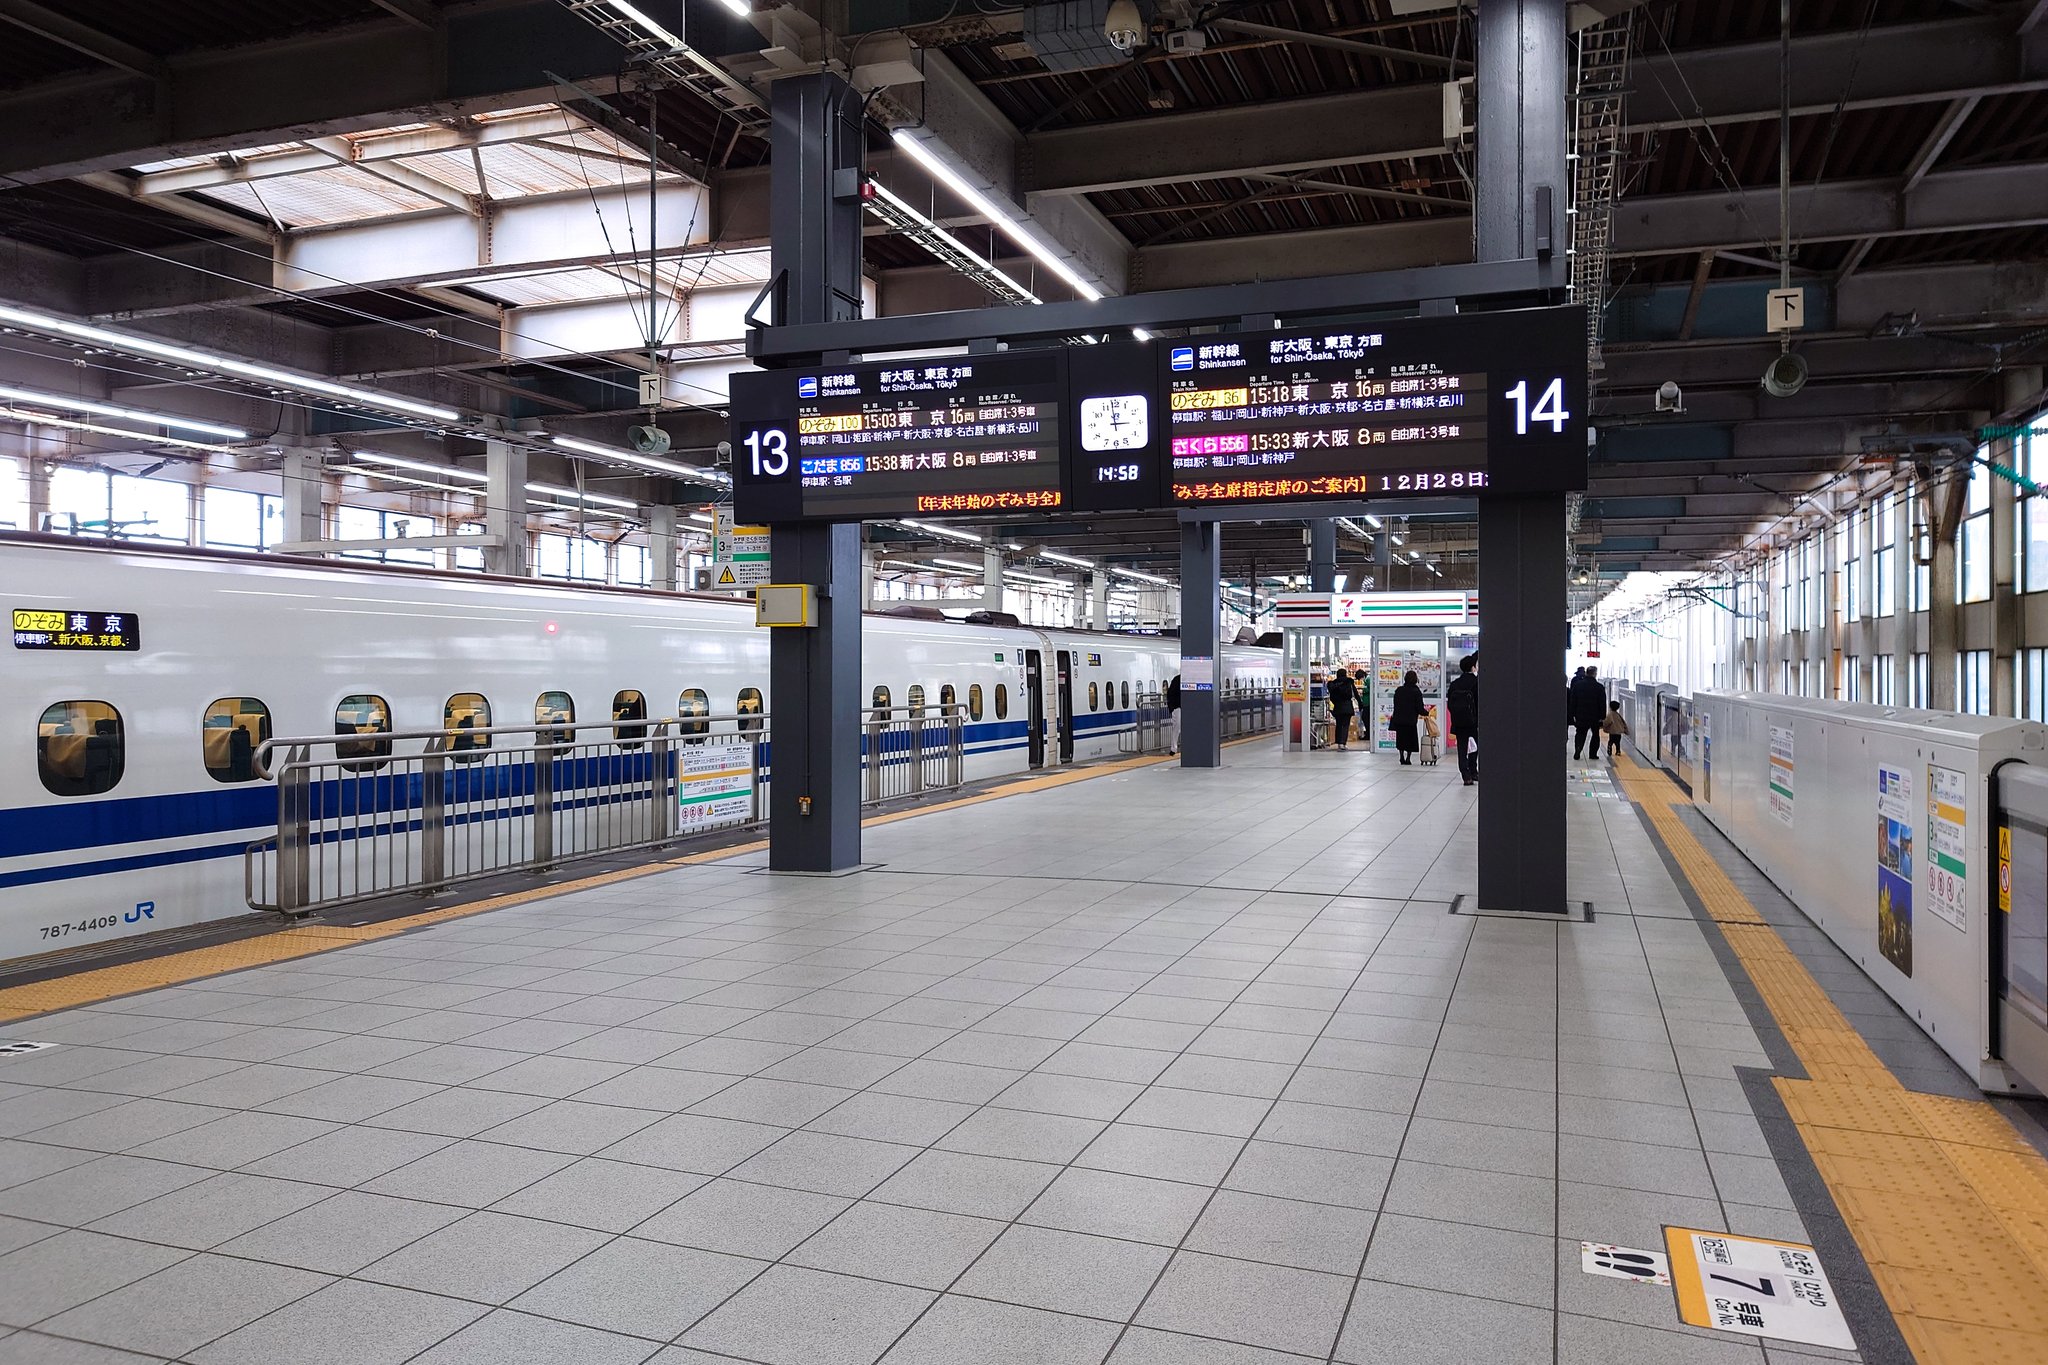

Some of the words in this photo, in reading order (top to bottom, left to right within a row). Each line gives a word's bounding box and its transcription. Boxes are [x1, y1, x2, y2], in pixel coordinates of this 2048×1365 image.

[1774, 294, 1799, 321] 下
[1198, 344, 1240, 360] 新幹線
[1270, 334, 1353, 354] 新大阪・東京
[1357, 333, 1383, 348] 方面
[1199, 358, 1247, 370] Shinkansen
[1270, 355, 1283, 364] for
[1284, 350, 1336, 362] Shin-Ōsaka,
[1337, 348, 1365, 359] Tōkyō
[642, 379, 658, 399] 下
[821, 374, 856, 388] 新幹線
[880, 367, 949, 384] 新大阪・東京
[951, 366, 973, 379] 方面
[821, 387, 861, 397] Shinkansen
[880, 384, 891, 393] for
[936, 380, 958, 390] Tōkyō
[1172, 393, 1217, 409] のぞみ
[1223, 391, 1240, 405] 36
[1250, 386, 1290, 405] 15:18
[1355, 380, 1385, 398] 16両
[1390, 377, 1460, 393] 自由席1-3号車
[1504, 377, 1570, 435] 14
[800, 417, 836, 432] のぞみ
[840, 416, 859, 429] 100
[864, 413, 897, 430] 15:03
[950, 408, 975, 425] 16両
[743, 429, 789, 476] 13
[1173, 439, 1218, 456] さくら
[1219, 436, 1244, 451] 556
[1251, 434, 1290, 451] 15:33
[1292, 429, 1350, 449] 新大阪
[1357, 427, 1386, 446] 8両
[1390, 425, 1460, 441] 自由席1-3号車
[801, 458, 838, 475] こだま
[840, 458, 861, 472] 856
[866, 455, 898, 471] 15:38
[900, 452, 947, 470] 新大阪
[952, 451, 976, 468] 8両
[1098, 465, 1139, 481] 14:58
[833, 475, 852, 486] 各駅
[1173, 475, 1367, 500] み号全席指定席のご案内】
[718, 514, 726, 525] 7
[718, 541, 726, 552] 3
[15, 612, 64, 629] のぞみ
[70, 613, 122, 633] 東京
[40, 915, 118, 940] 787-4409
[124, 901, 155, 923] JR
[1792, 1252, 1815, 1275] のぞみ
[1709, 1273, 1776, 1297] 7
[1803, 1282, 1828, 1307] ひかり
[1714, 1298, 1731, 1312] Car
[1733, 1302, 1765, 1328] 号車
[1718, 1313, 1736, 1326] No.
